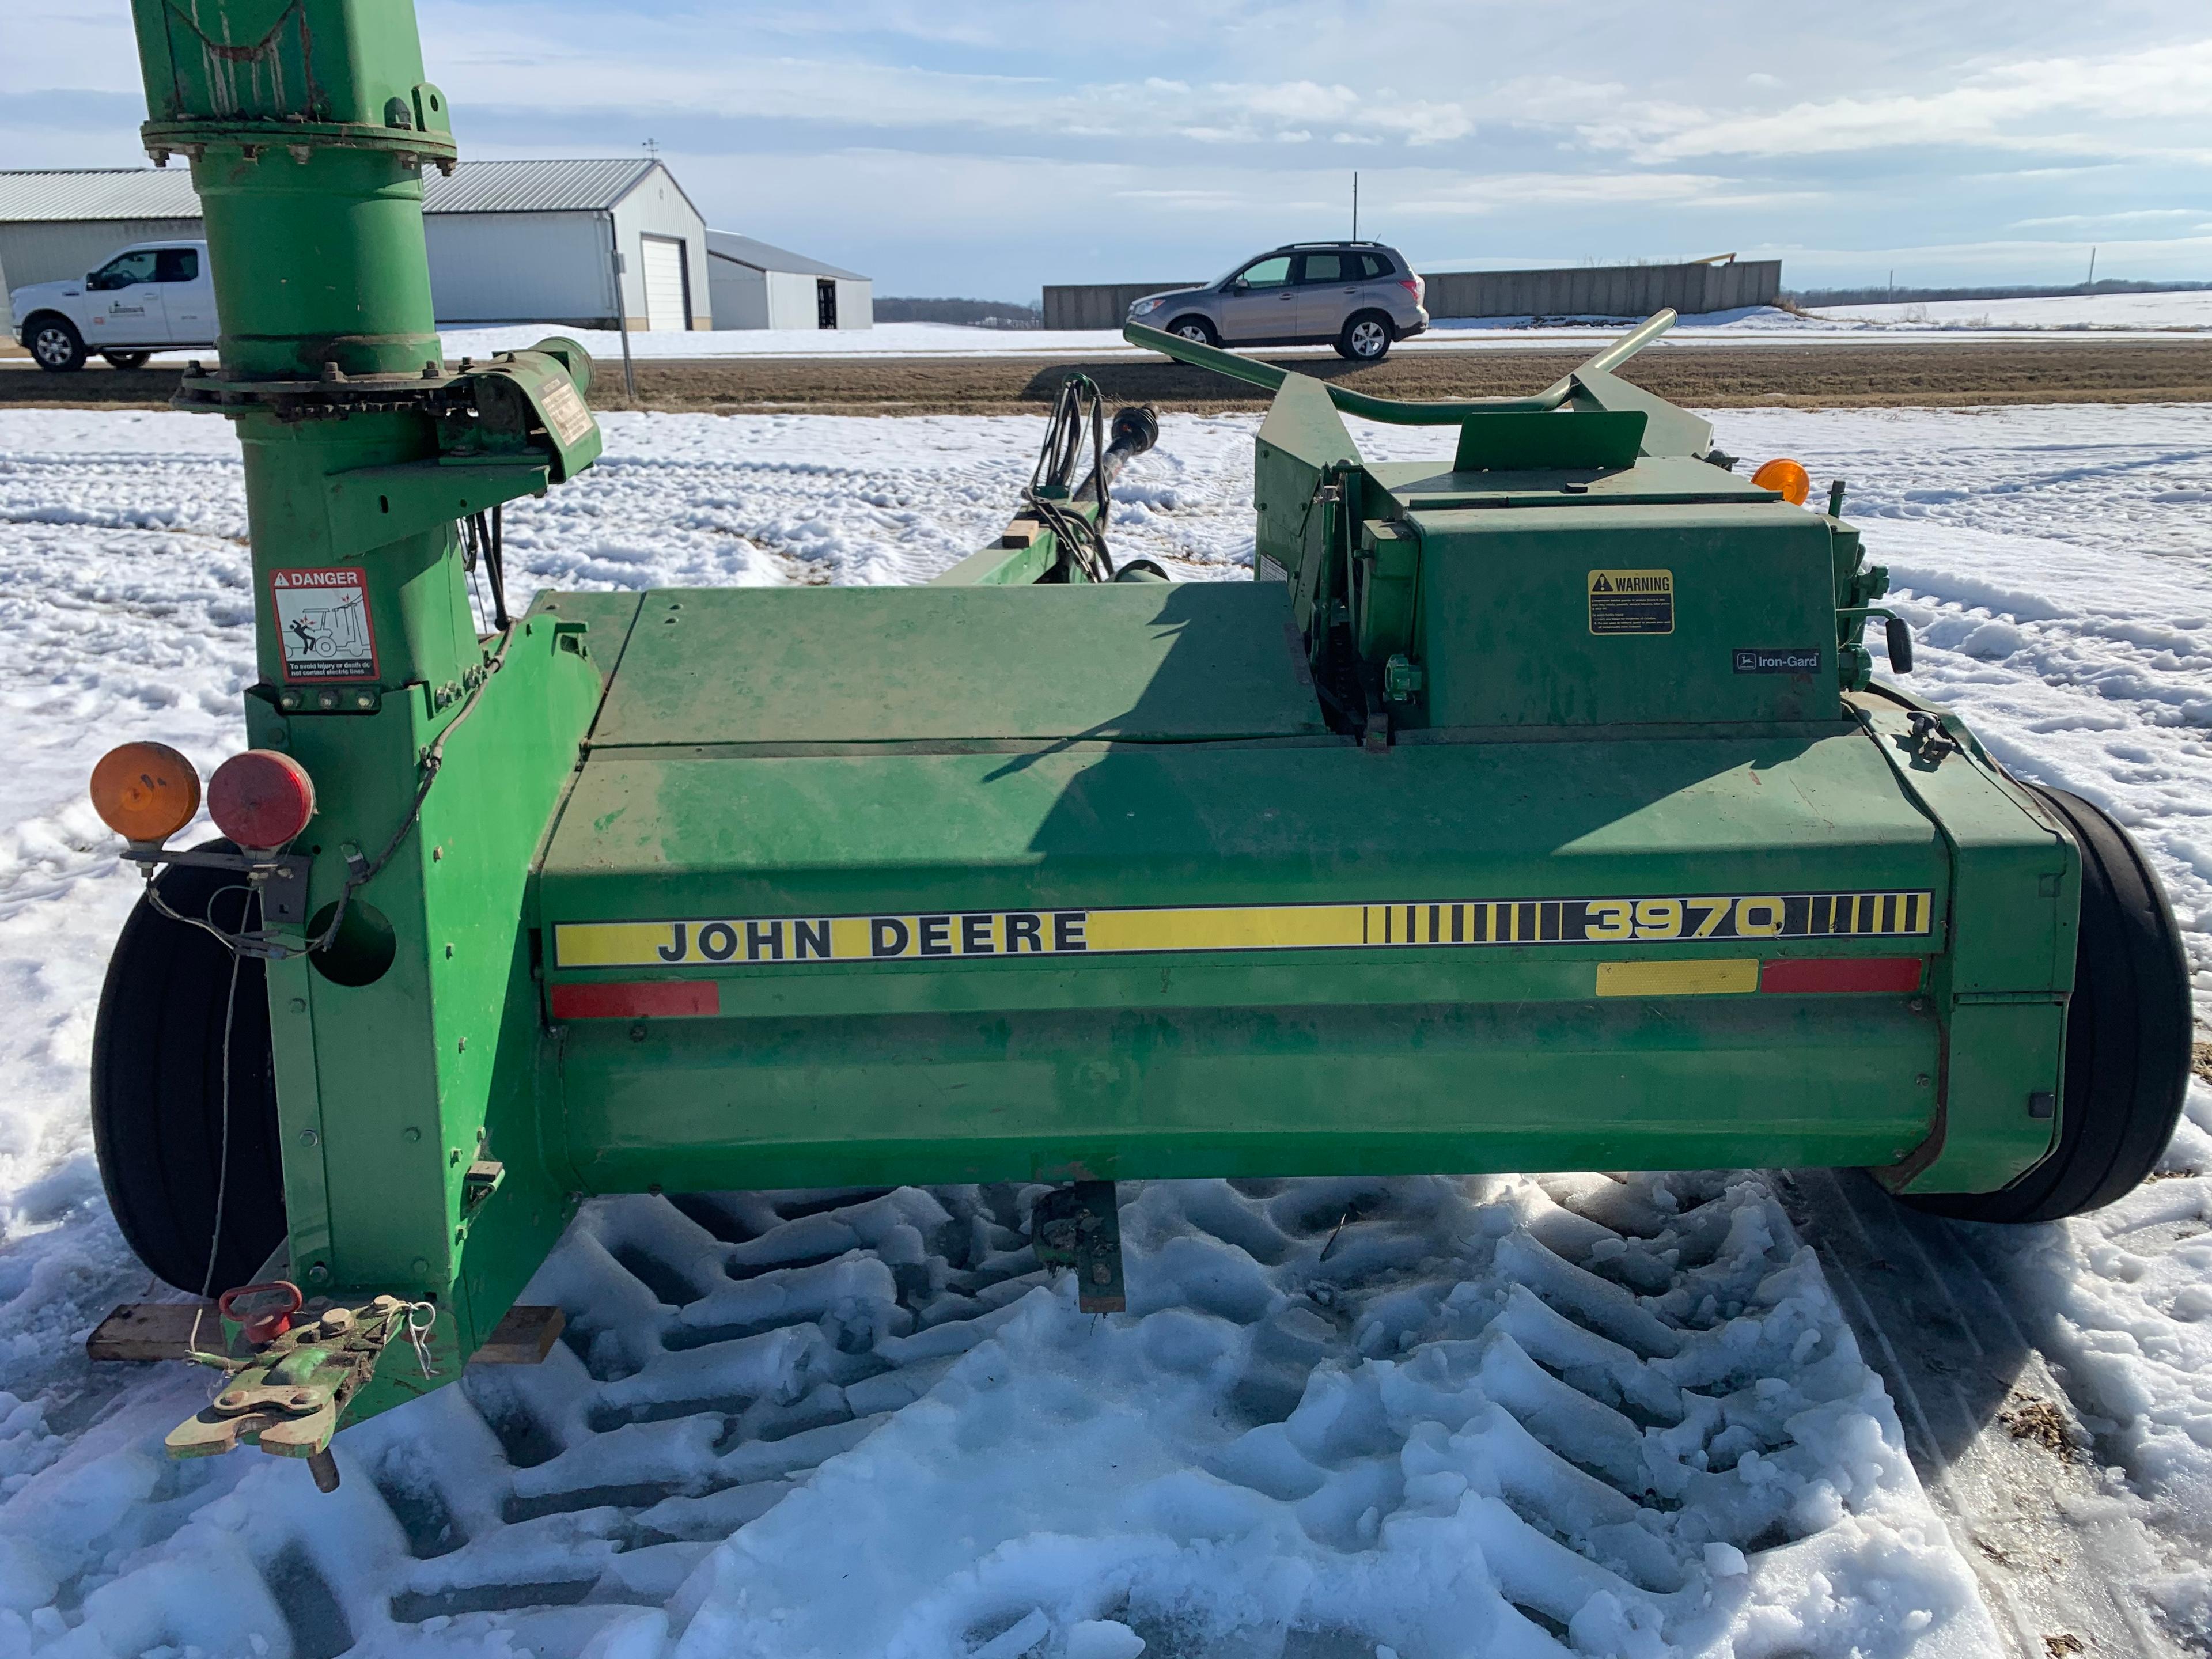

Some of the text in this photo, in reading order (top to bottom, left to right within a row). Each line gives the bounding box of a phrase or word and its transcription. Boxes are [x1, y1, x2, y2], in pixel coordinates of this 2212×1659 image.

[291, 572, 358, 585] DANGER
[1615, 577, 1669, 592] WARNING
[1759, 656, 1817, 667] Iron-Gard
[1585, 897, 1785, 940] 3970
[658, 912, 1088, 962] JOHN DEERE
